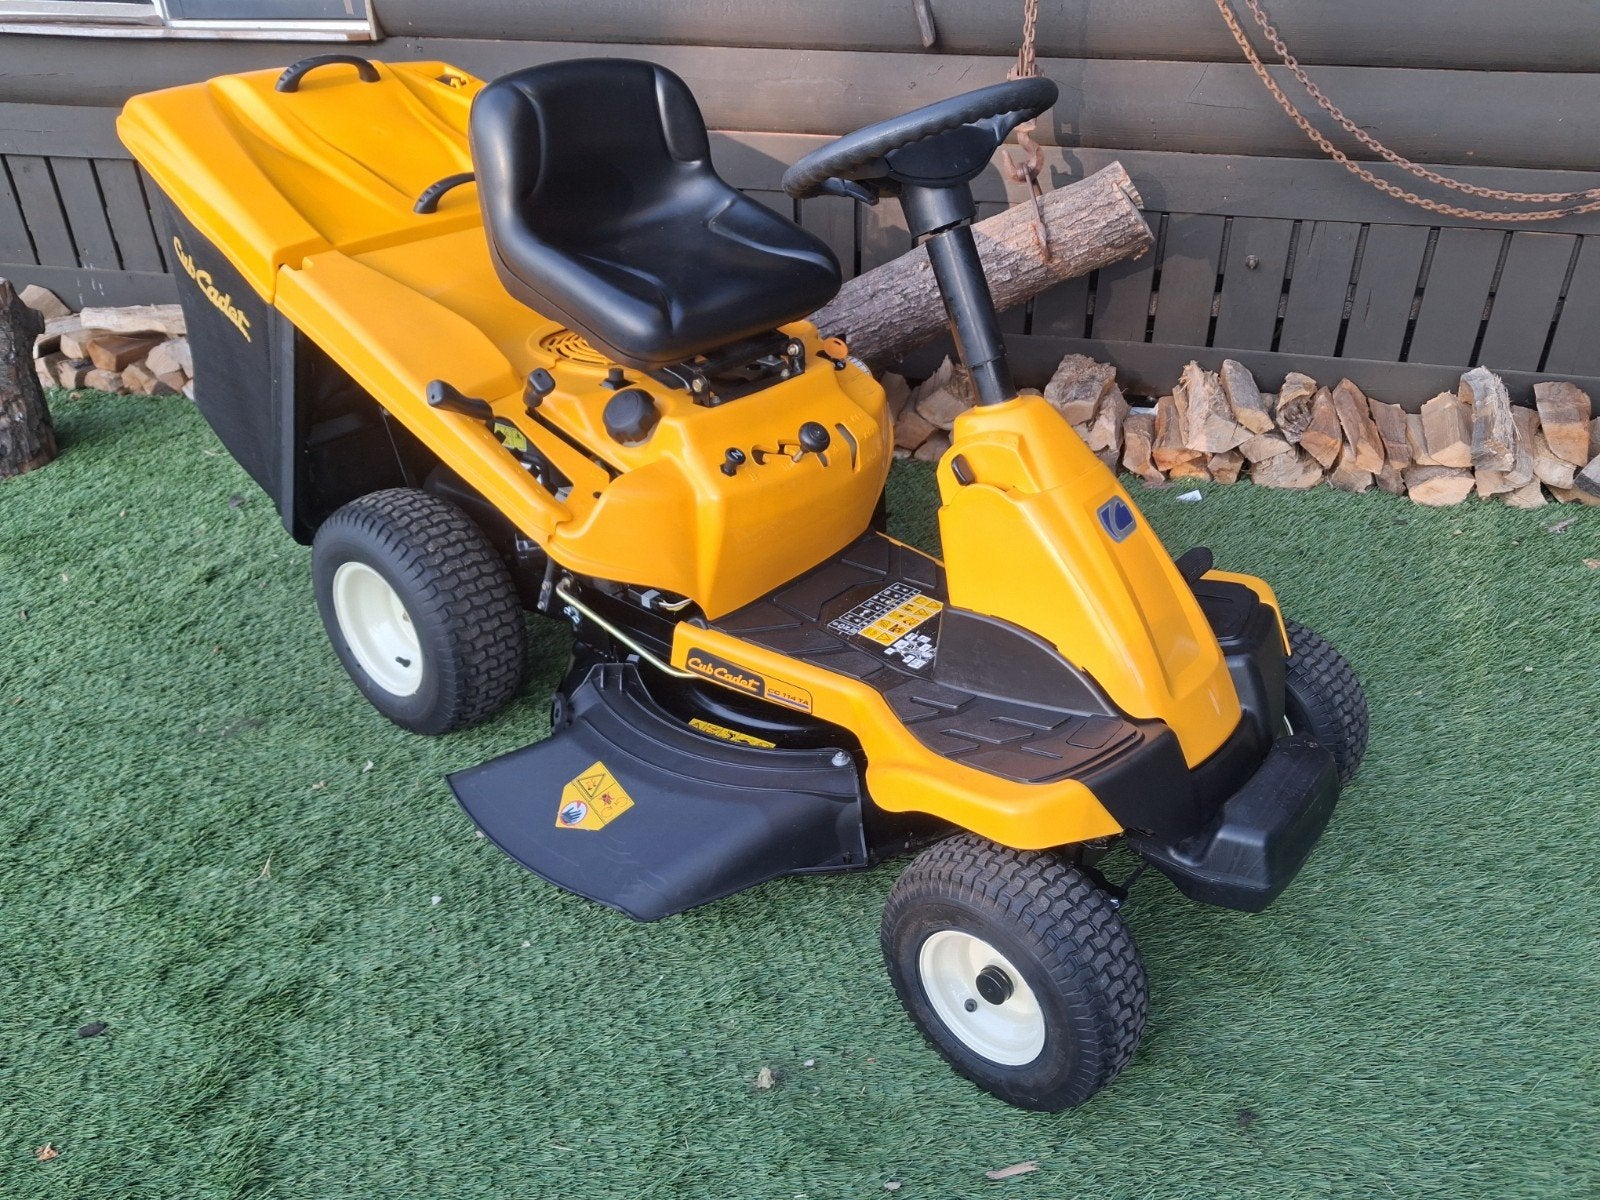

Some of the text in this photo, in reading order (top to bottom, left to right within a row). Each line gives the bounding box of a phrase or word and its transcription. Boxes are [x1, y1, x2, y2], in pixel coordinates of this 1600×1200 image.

[173, 236, 252, 343] Cub Cadet
[688, 657, 760, 692] Cub Cadet
[782, 692, 796, 701] 114
[798, 697, 809, 706] TA
